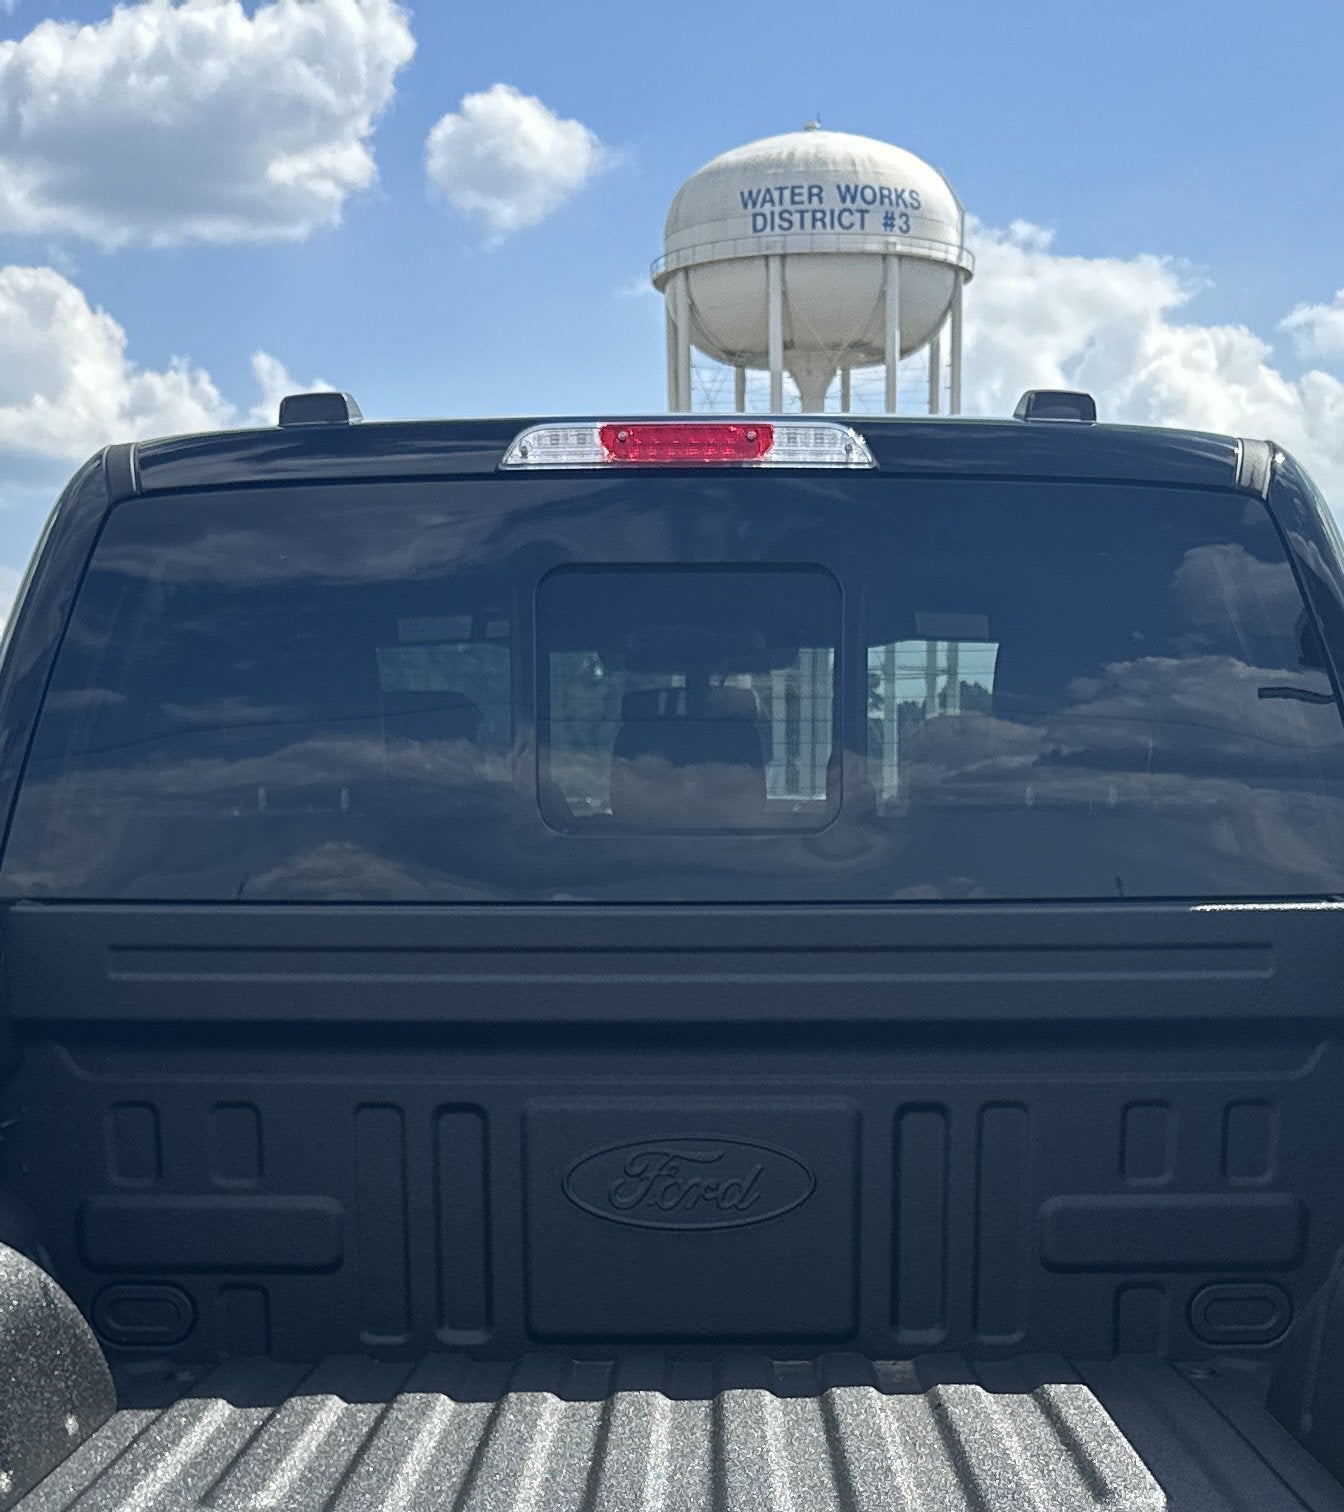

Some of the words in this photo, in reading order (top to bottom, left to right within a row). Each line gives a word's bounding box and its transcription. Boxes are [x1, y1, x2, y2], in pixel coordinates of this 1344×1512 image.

[739, 184, 824, 211] WATER
[836, 184, 922, 211] WORKS
[752, 208, 871, 234] DISTRICT
[882, 210, 912, 234] #3
[609, 1149, 763, 1212] Ford
